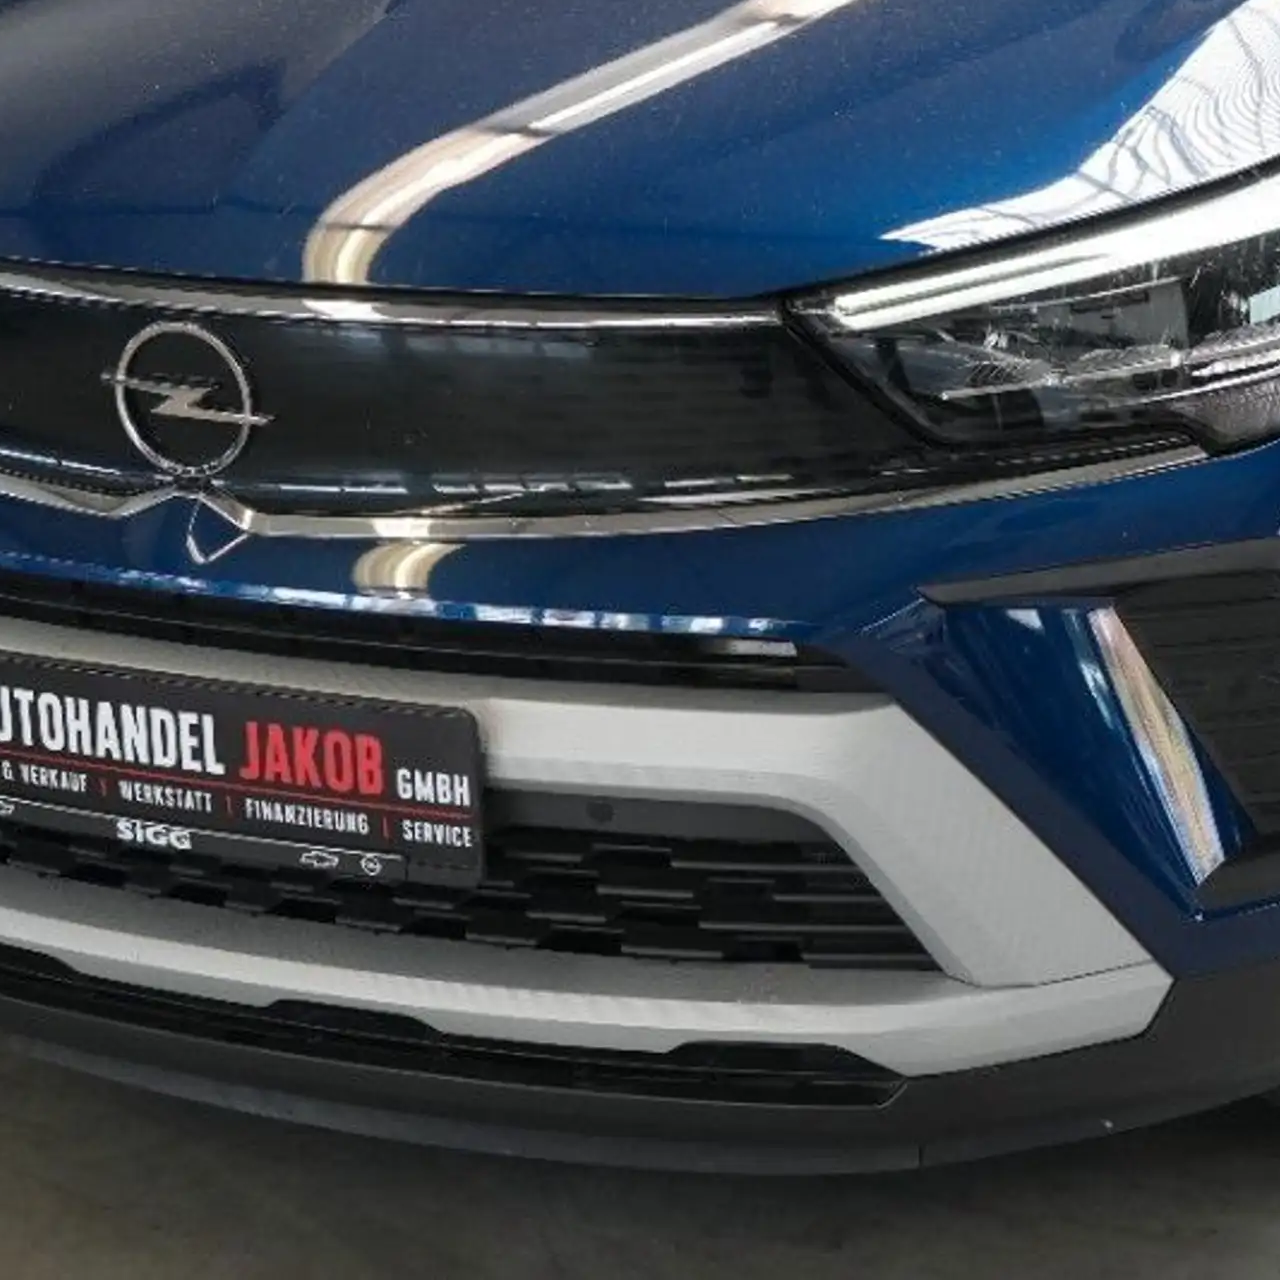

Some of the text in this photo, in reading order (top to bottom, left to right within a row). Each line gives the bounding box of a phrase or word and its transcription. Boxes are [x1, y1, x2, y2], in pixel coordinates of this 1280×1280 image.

[19, 762, 88, 794] VERKAUF
[117, 779, 213, 814] WERKSTATT
[243, 797, 370, 836] FINANZIERUNG
[401, 818, 473, 849] SERVICE
[239, 720, 384, 795] JAKOB
[395, 766, 471, 807] GMBH
